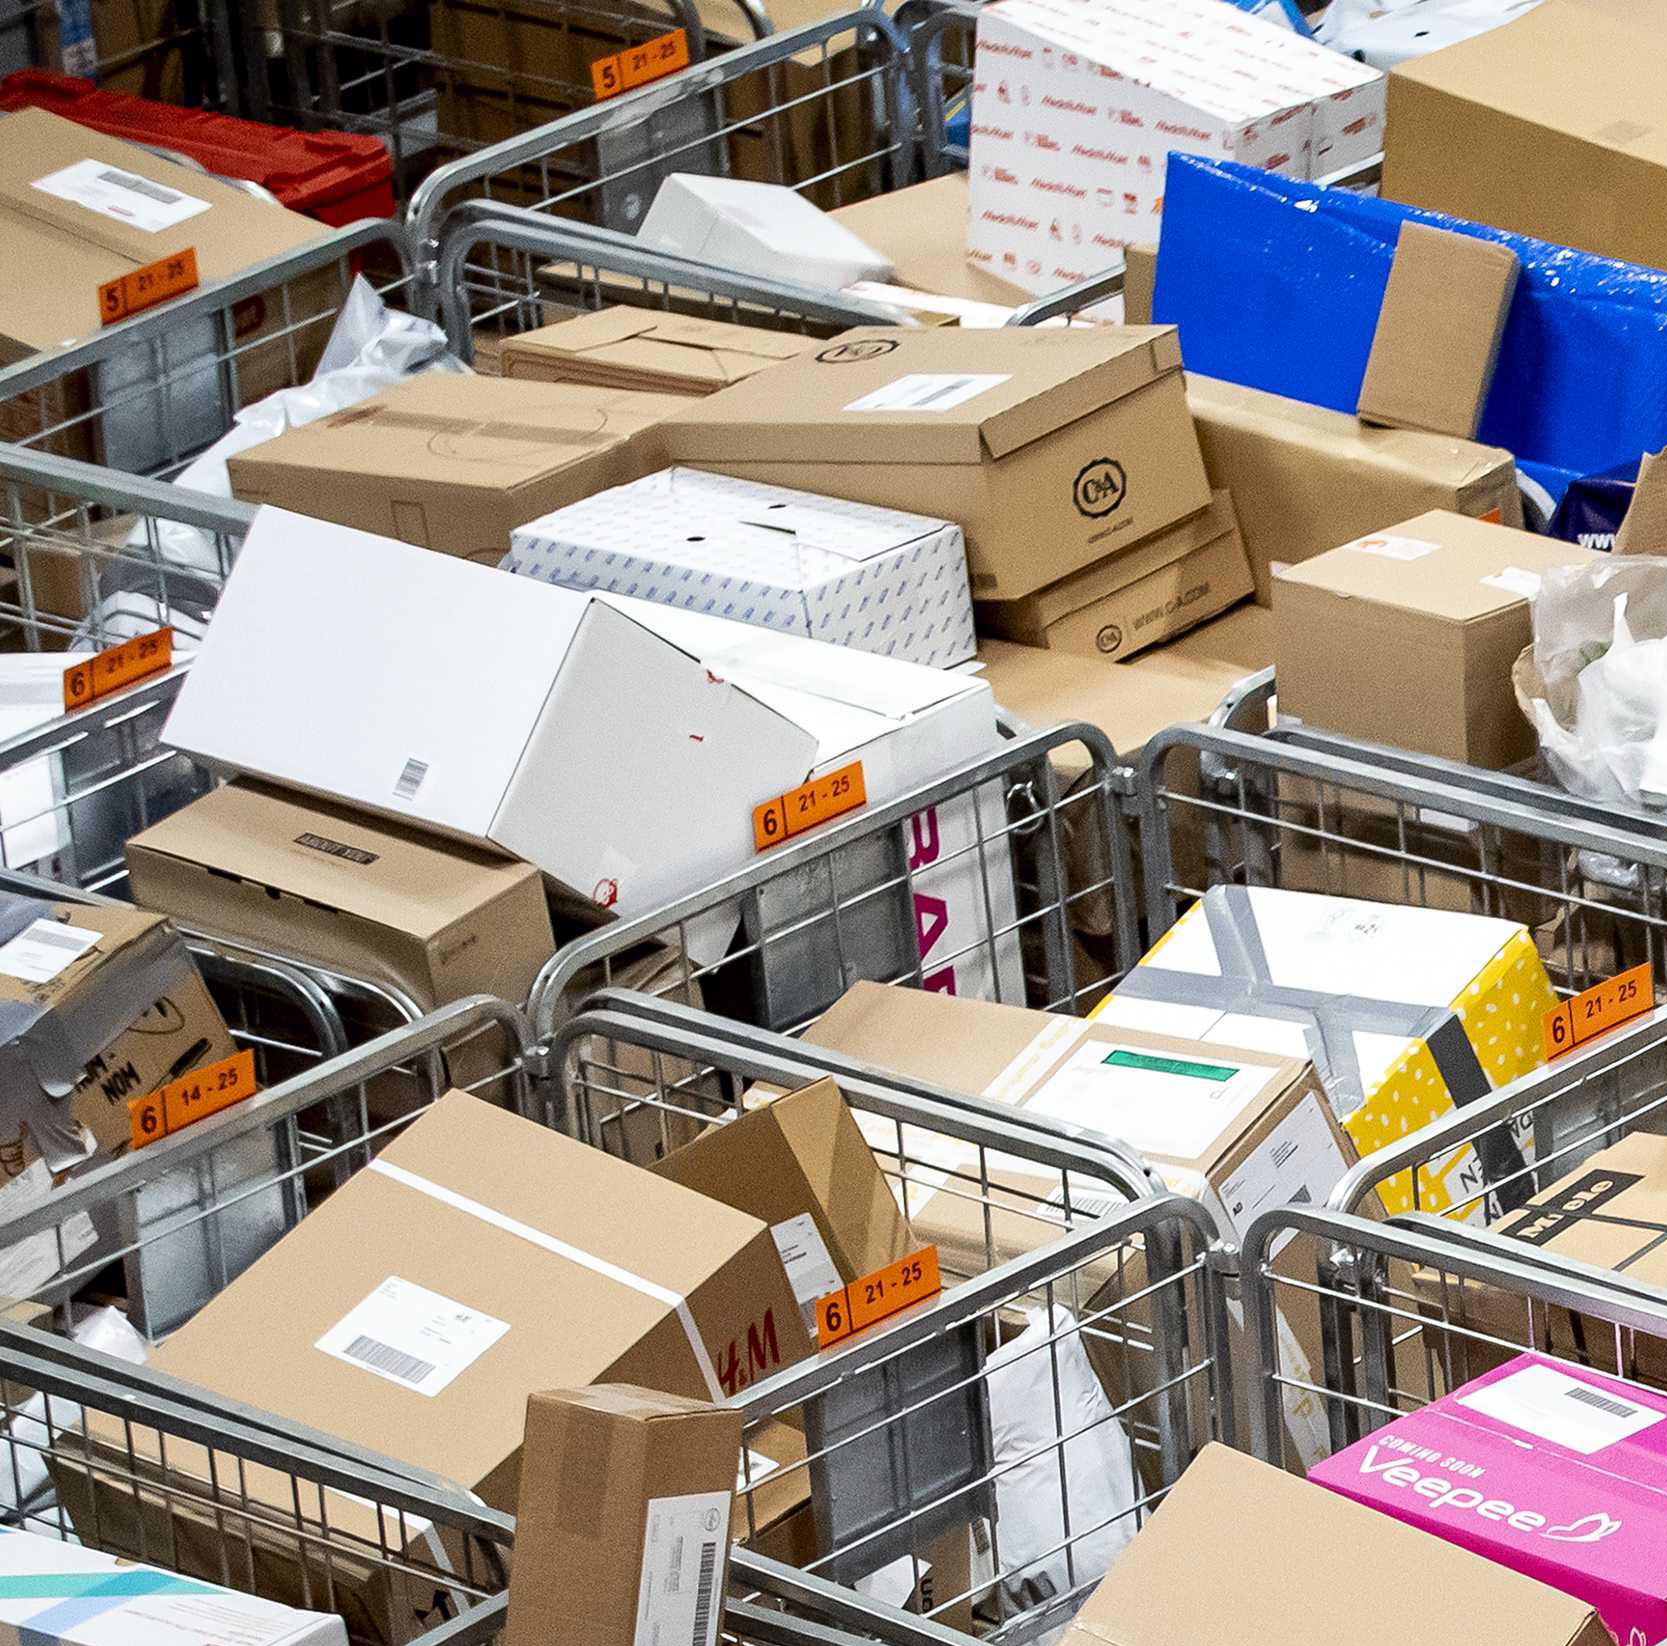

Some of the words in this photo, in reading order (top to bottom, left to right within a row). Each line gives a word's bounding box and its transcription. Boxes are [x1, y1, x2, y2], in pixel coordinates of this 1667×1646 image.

[798, 793, 817, 812] 21
[831, 780, 850, 800] 25
[763, 810, 777, 835] 6
[1585, 998, 1602, 1019] 21
[1618, 981, 1637, 1002] 25
[1552, 1016, 1564, 1043] 6
[182, 1085, 202, 1105] 14
[219, 1072, 239, 1091] 25
[142, 1110, 158, 1135] 6
[864, 1284, 884, 1305] 21
[901, 1266, 922, 1288] 25
[825, 1303, 842, 1331] 6
[1378, 1434, 1436, 1465] COMING
[1438, 1450, 1485, 1479] SOON
[1359, 1445, 1547, 1533] Veepee
